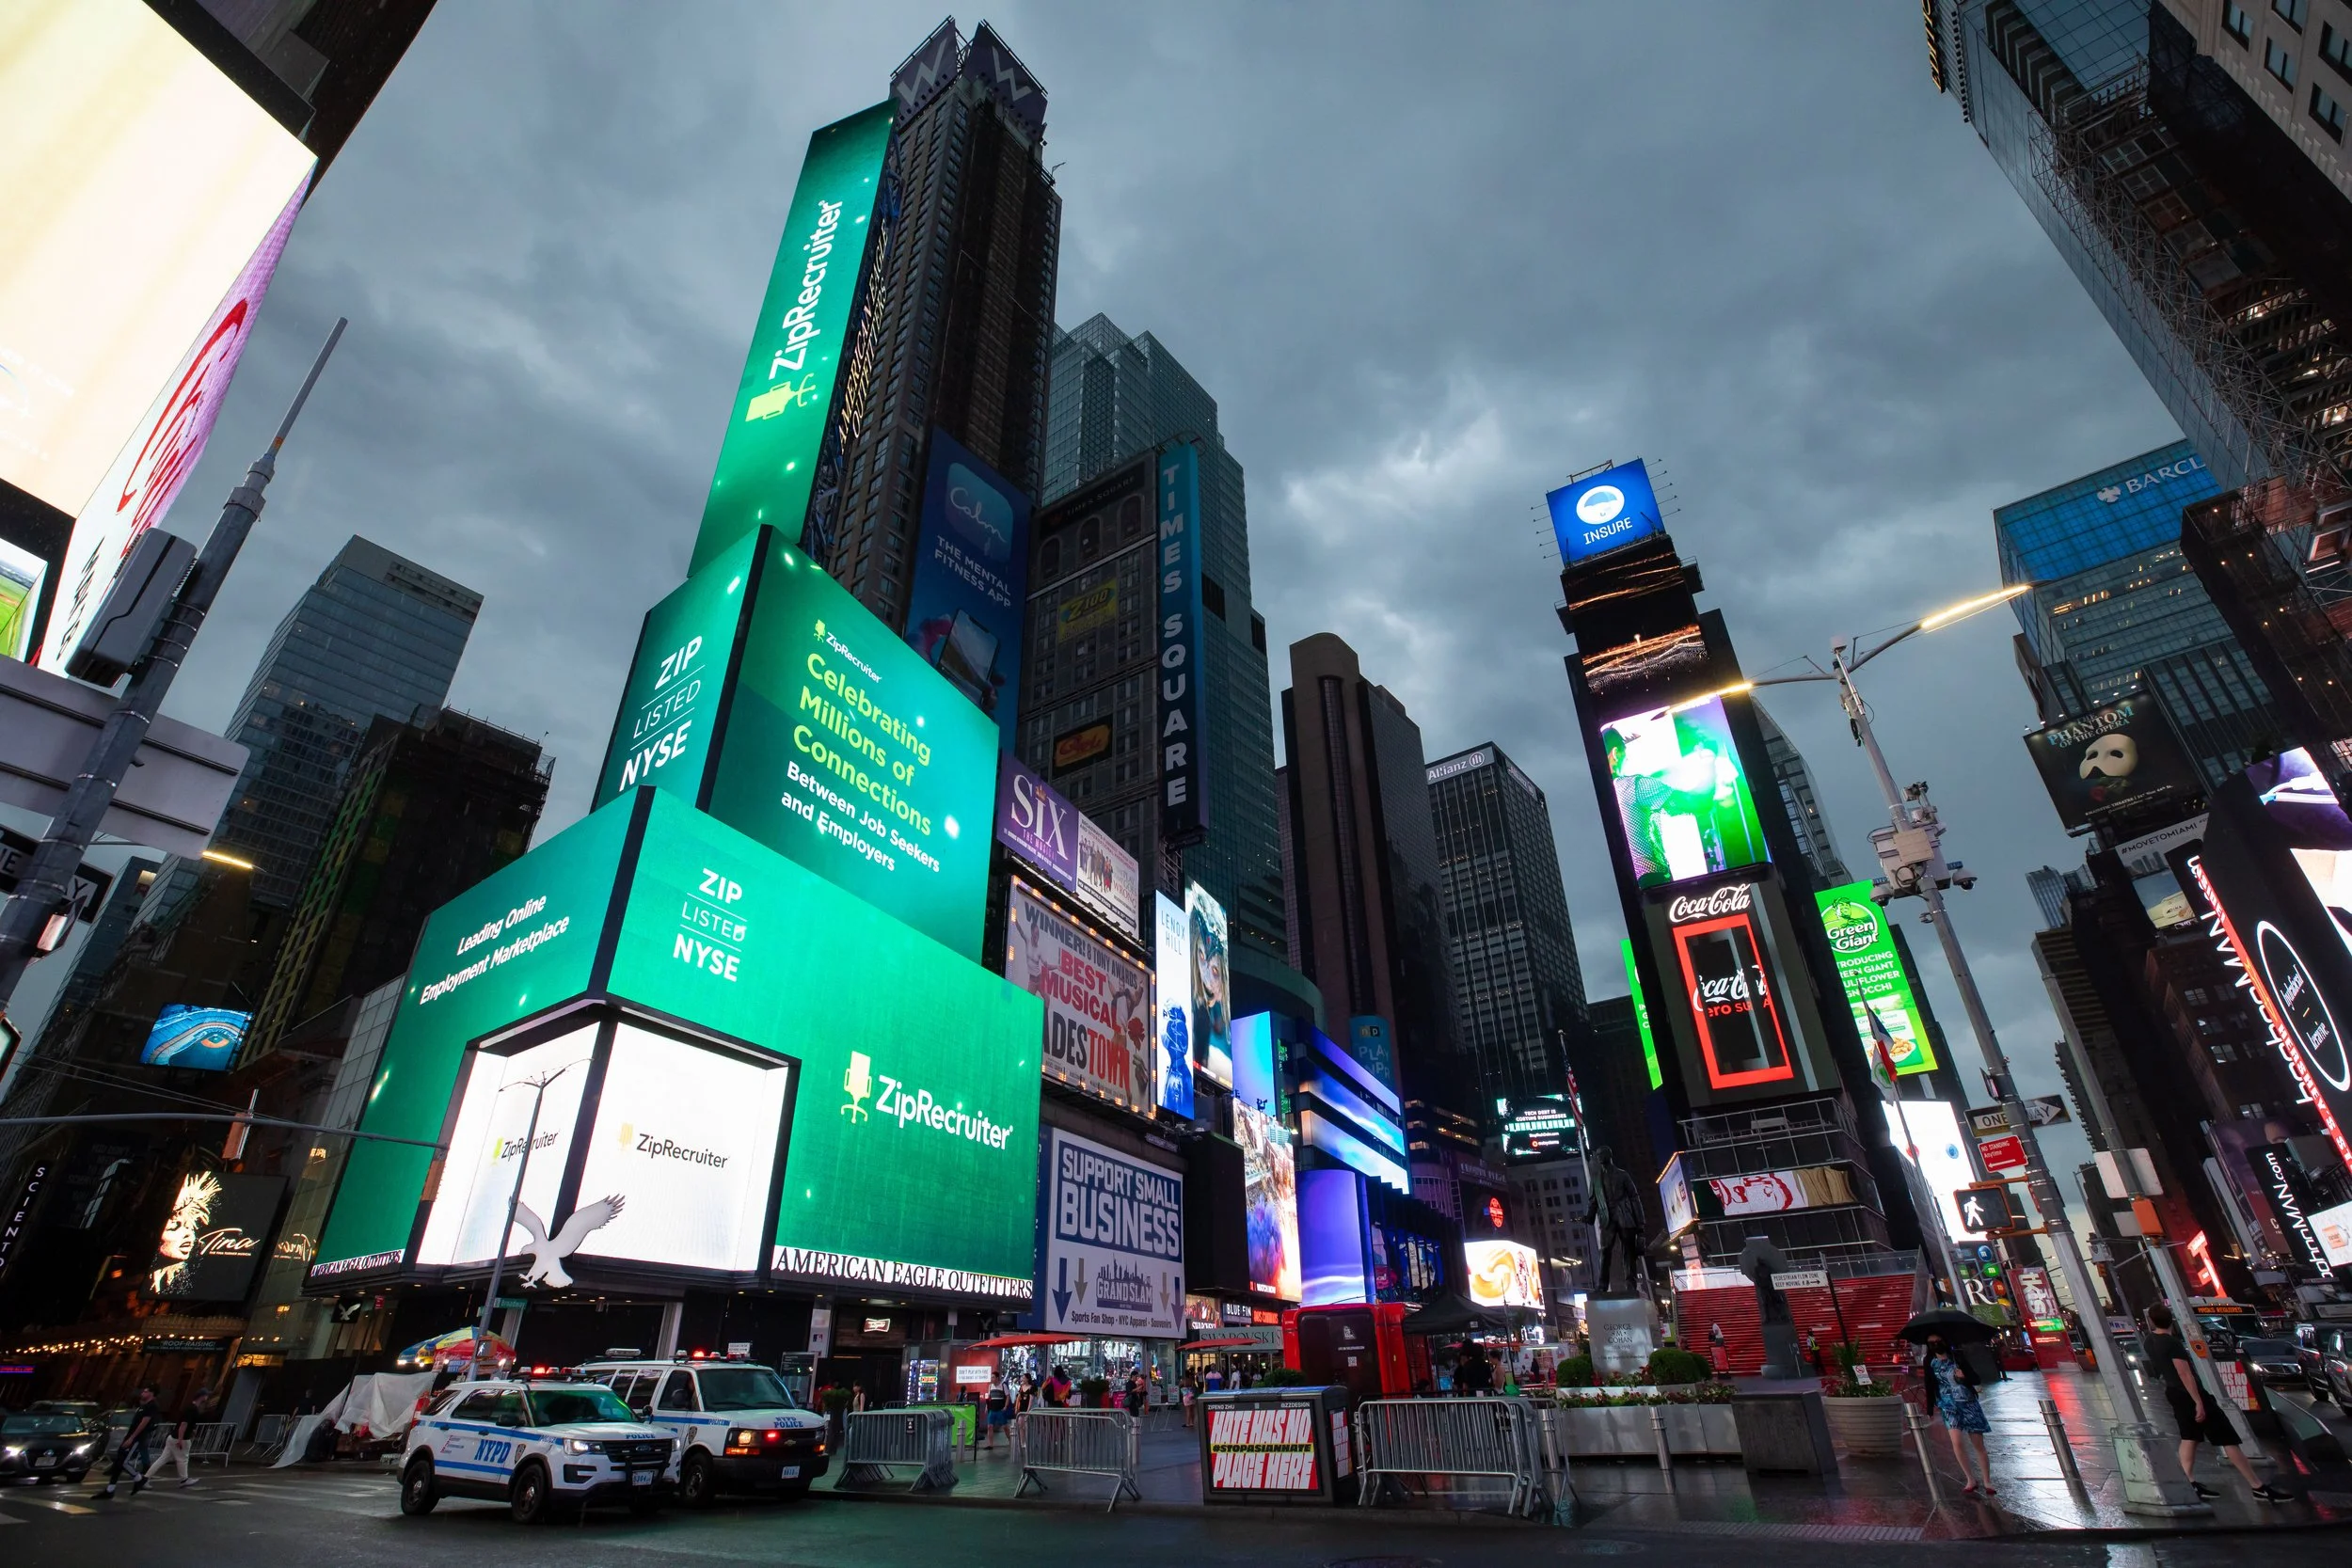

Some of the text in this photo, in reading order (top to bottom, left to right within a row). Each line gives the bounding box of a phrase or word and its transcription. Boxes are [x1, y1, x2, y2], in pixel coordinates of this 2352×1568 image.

[897, 37, 947, 107] W
[993, 46, 1031, 99] W
[769, 200, 842, 381] ZipRecruiter
[839, 294, 872, 451] AMERICAN
[852, 277, 887, 438] OUTFITTERS
[2125, 454, 2206, 494] BARCL
[949, 486, 1008, 544] Calm
[1583, 516, 1633, 546] INSURE
[934, 548, 1011, 609] FITNESS APP
[936, 535, 1011, 595] THE MENTAL
[1068, 589, 1109, 621] Z100
[1160, 464, 1188, 806] TIMES SQUARE
[655, 635, 703, 689] ZIP
[825, 632, 882, 684] ZipRecruiter
[633, 680, 702, 738] LISTED
[806, 652, 931, 767] Celebrating
[2046, 706, 2135, 746] PHANTOM
[798, 686, 915, 788] Millions of
[2058, 719, 2130, 748] OF THE OPERA
[619, 720, 691, 792] NYSE
[1427, 760, 1467, 781] Allianz
[793, 724, 931, 836] Connections
[781, 790, 896, 872] and Employers
[787, 760, 940, 873] Between Job Seekers
[1011, 774, 1069, 862] SIX
[2121, 823, 2198, 854] #MOVETOMIAMI
[699, 867, 743, 906] ZIP
[1669, 883, 1751, 923] Coca-Cola
[456, 894, 547, 957] Leading Online
[682, 901, 747, 942] LISTED
[1161, 910, 1185, 939] LENOX
[1827, 922, 1875, 940] Green
[1836, 932, 1880, 950] Giant
[420, 914, 570, 1006] Employment Marketplace
[674, 933, 741, 982] NYSE
[1025, 900, 1087, 958] WINNER!
[1087, 943, 1092, 959] 8
[1093, 947, 1110, 972] TONY
[1111, 958, 1138, 990] AWARDS
[1165, 930, 1183, 956] HILL
[1060, 946, 1108, 997] BEST
[1864, 961, 1895, 974] GIANT
[1039, 965, 1122, 1033] MUSICAL
[1359, 1044, 1389, 1061] PLAY
[2278, 1023, 2336, 1131] HERSHEY'S
[876, 1074, 1013, 1149] ZipRecruiter
[1982, 1113, 2010, 1127] ONE
[501, 1131, 559, 1162] ZipReruiter
[636, 1134, 730, 1169] ZipRecruiter
[1984, 1149, 2003, 1159] Anytime
[1988, 1140, 2010, 1150] STANDING
[1062, 1148, 1178, 1211] SUPPORT SMALL
[1059, 1180, 1180, 1258] BUSINESS
[2265, 1152, 2334, 1278] boohooMAN.com
[199, 1227, 261, 1256] Tina
[777, 1247, 1033, 1299] AMERICAN EAGLE OUTFITTERS
[1097, 1276, 1152, 1305] GRAND SLAM
[1963, 1278, 1998, 1306] R
[1071, 1310, 1172, 1329] Sports Fan Shop NYC Apparel Souvenirs
[1226, 1304, 1240, 1316] BLUE
[1603, 1323, 1633, 1331] GEORGE
[2233, 1372, 2248, 1386] NO
[1210, 1409, 1312, 1444] HATE HAS NO
[473, 1438, 513, 1465] NYPD
[1212, 1444, 1311, 1453] #STOPASIANHATE
[1214, 1452, 1315, 1489] PLACE HERE
